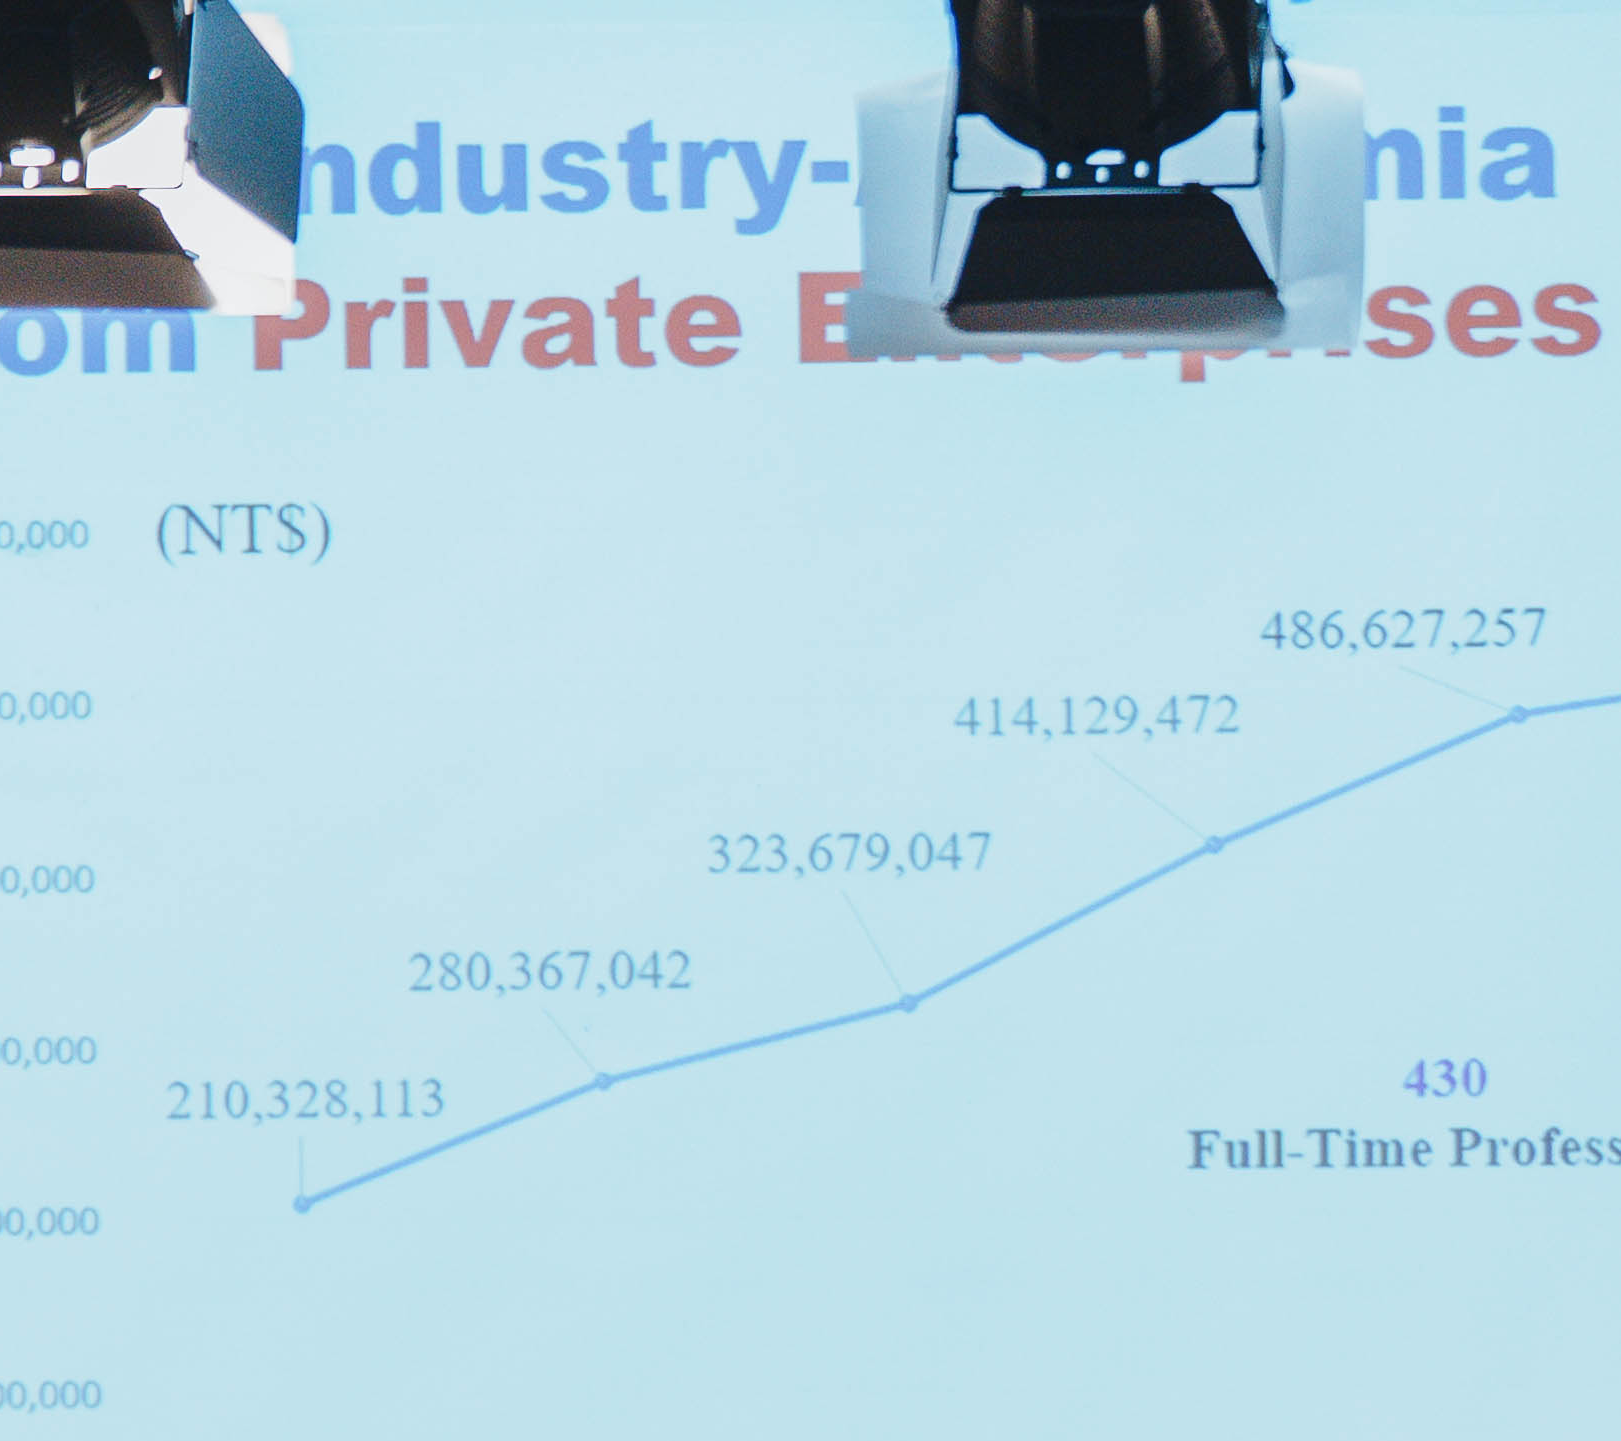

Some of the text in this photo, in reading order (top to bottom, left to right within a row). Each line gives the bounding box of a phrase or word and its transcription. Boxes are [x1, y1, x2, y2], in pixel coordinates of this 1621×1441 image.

[253, 276, 742, 371] Private
[157, 503, 332, 564] (NT$)
[1261, 607, 1545, 650] 486,627,257
[955, 694, 1239, 737] 414,129,472
[709, 831, 991, 876] 323,679,047
[410, 950, 690, 994] 280,367,042
[1404, 1058, 1487, 1097] 430
[168, 1078, 444, 1123] 210,328,113
[1190, 1129, 1432, 1169] Full-Time
